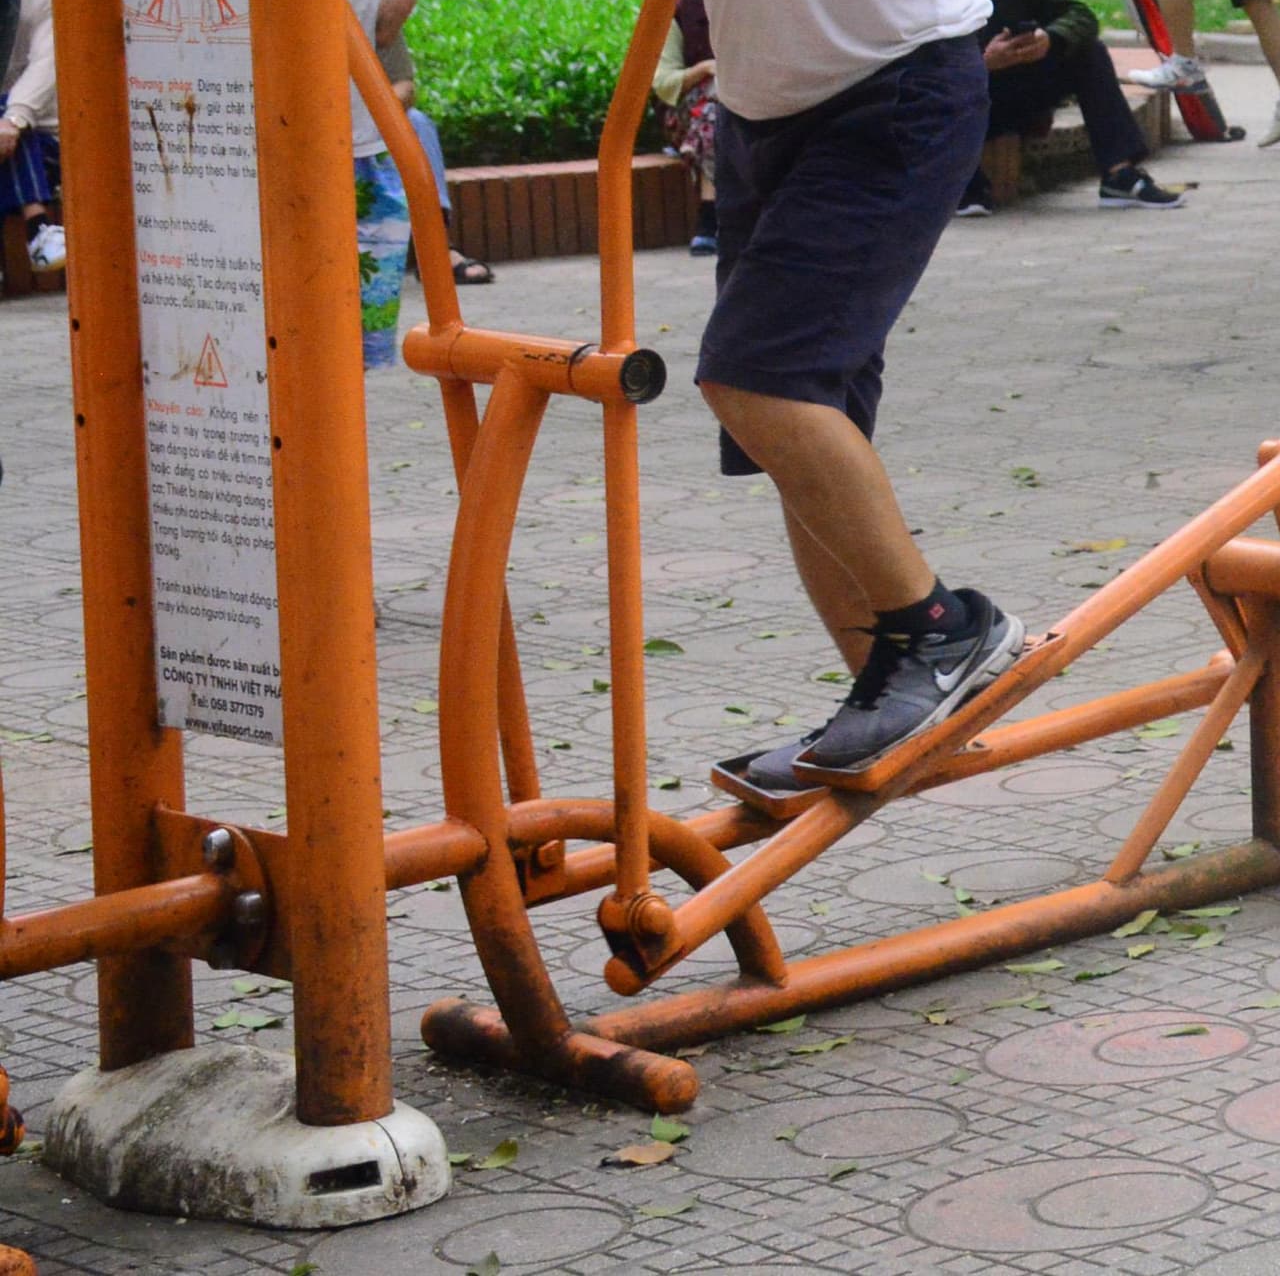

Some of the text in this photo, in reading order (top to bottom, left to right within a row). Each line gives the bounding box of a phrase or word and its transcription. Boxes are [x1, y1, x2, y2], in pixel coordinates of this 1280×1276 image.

[195, 673, 207, 686] TY
[211, 676, 238, 691] TNHH
[211, 698, 227, 712] 058
